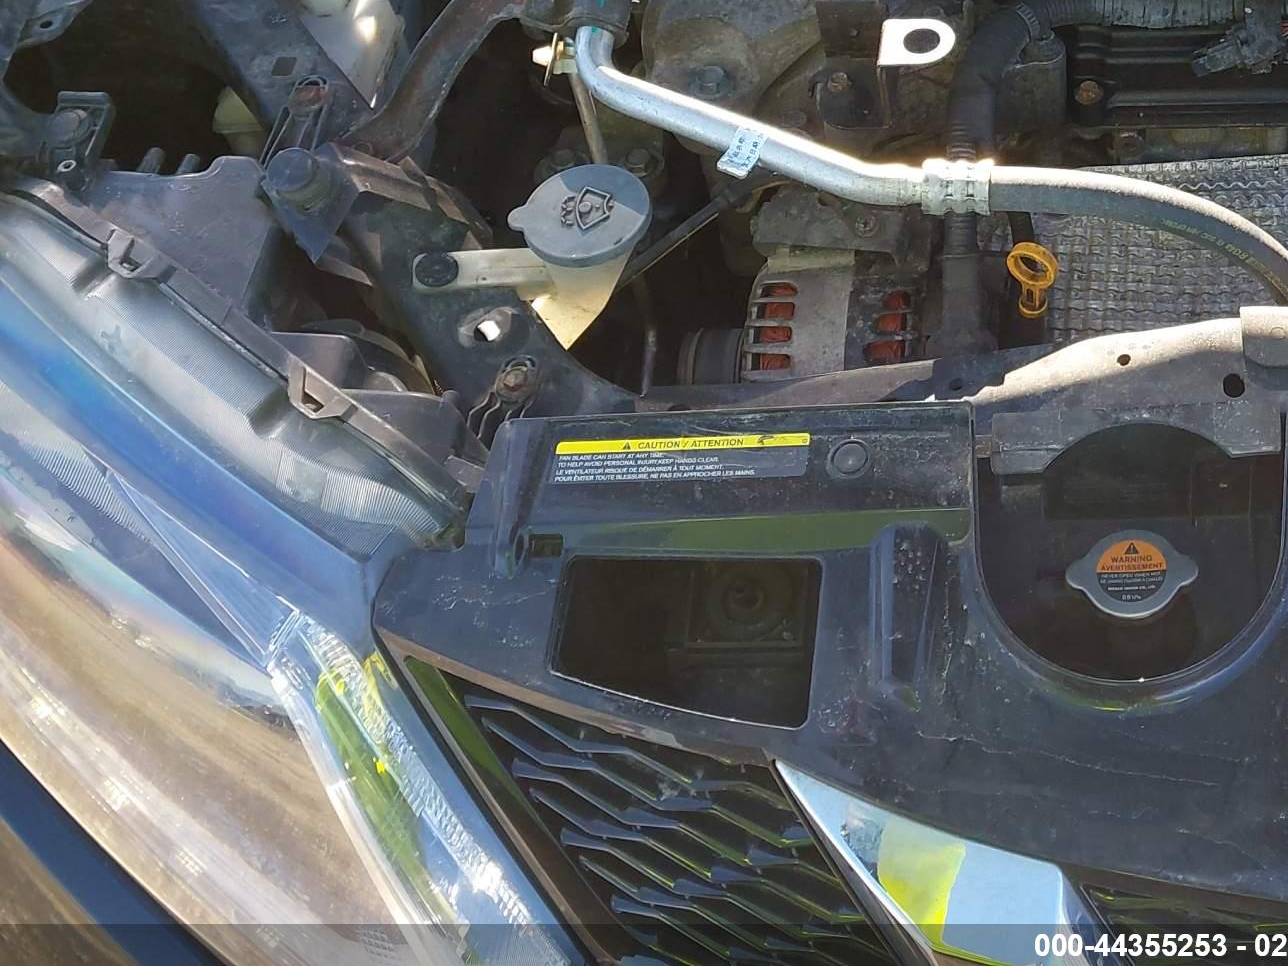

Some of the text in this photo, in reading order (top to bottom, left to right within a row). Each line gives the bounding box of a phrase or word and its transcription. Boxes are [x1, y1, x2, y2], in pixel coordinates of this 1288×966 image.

[638, 441, 680, 449] CAUTION
[691, 438, 744, 447] ATTENTION
[1111, 554, 1152, 562] WARNING
[1101, 563, 1162, 571] AVERTISSEMENT
